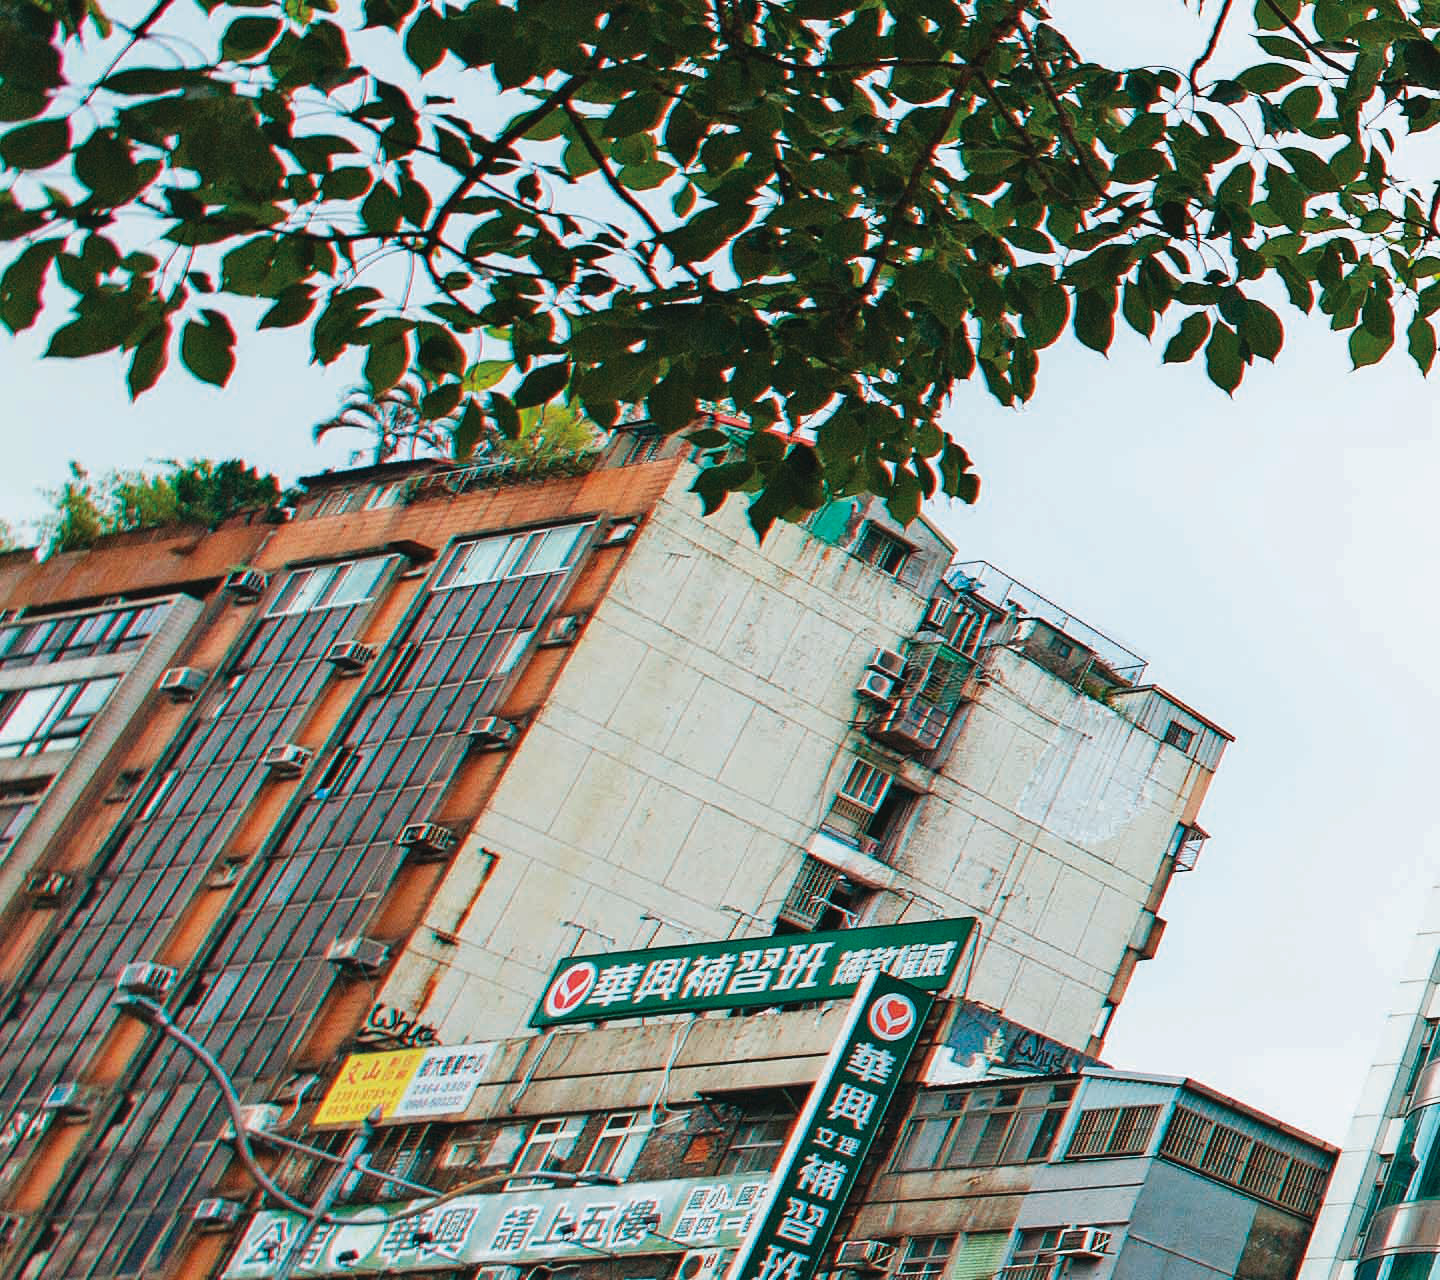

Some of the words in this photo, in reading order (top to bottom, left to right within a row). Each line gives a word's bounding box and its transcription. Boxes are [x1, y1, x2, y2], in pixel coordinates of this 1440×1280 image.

[585, 940, 835, 1008] 華興補習班
